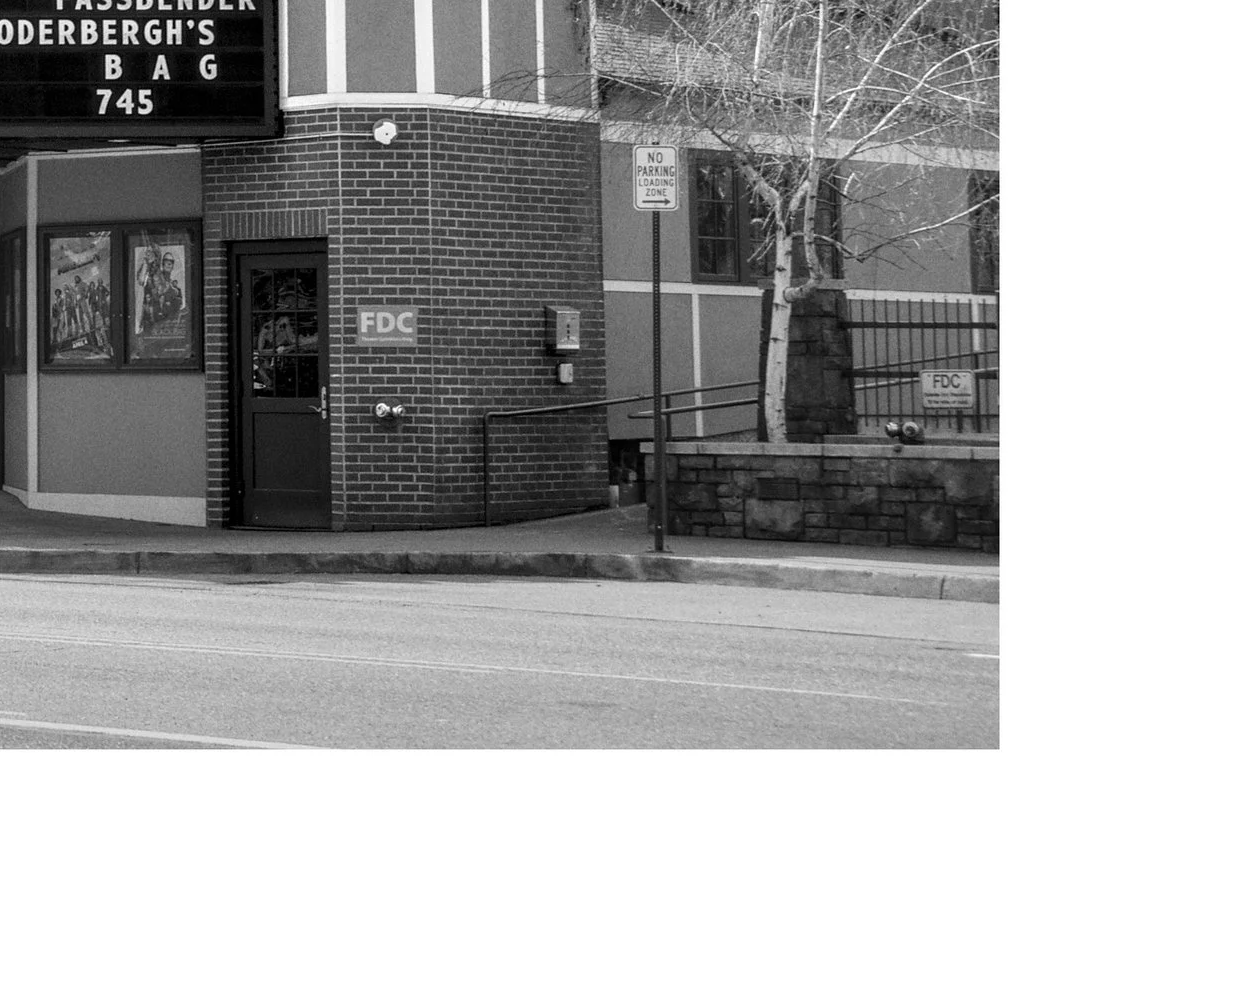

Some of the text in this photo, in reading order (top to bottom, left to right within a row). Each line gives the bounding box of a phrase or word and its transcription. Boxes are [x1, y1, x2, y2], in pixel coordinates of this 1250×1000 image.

[96, 88, 154, 115] 745
[647, 151, 663, 164] NO
[637, 165, 675, 177] PARKING
[638, 178, 675, 187] LOADING
[645, 188, 667, 197] ZONE
[360, 311, 414, 333] FDC
[933, 373, 961, 389] FDC
